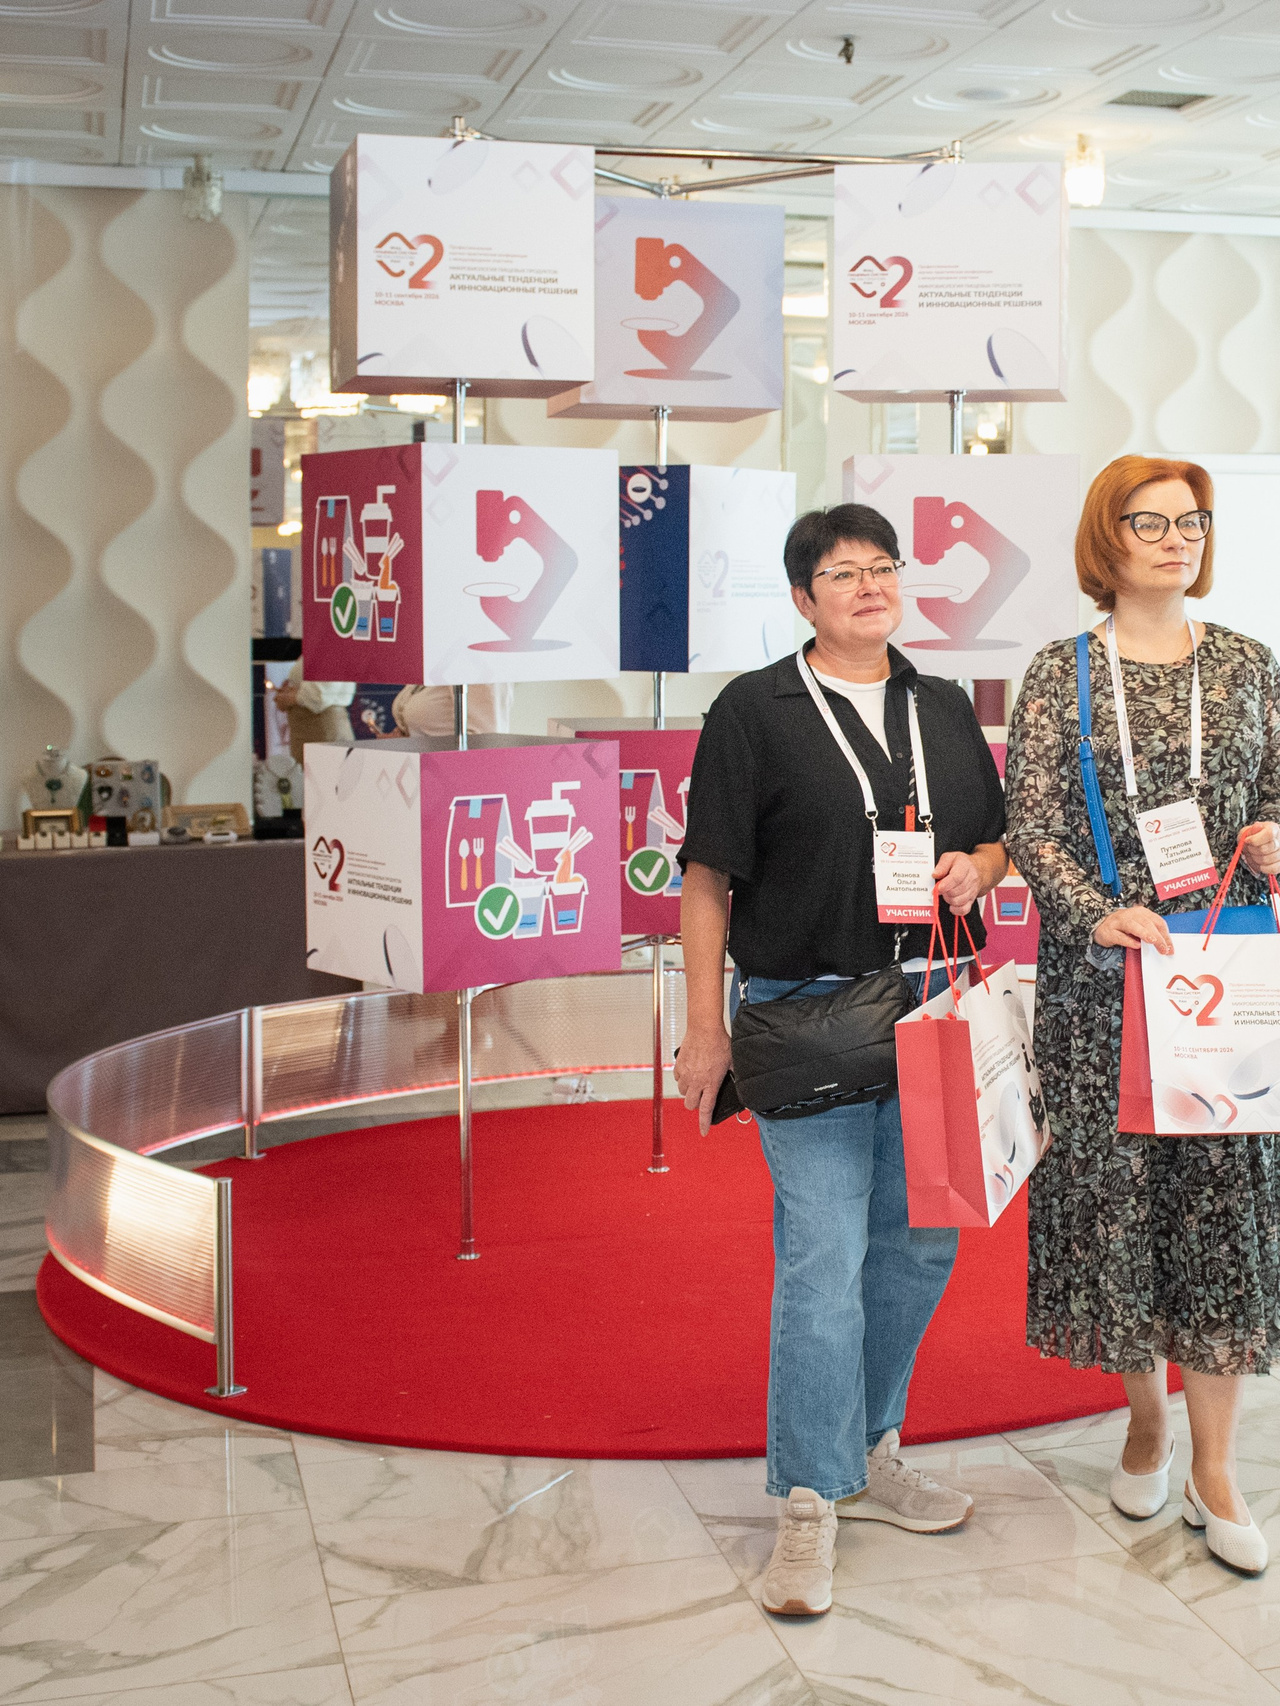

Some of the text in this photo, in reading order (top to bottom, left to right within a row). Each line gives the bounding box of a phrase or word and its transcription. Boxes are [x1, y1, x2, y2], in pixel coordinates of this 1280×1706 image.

[449, 273, 558, 285] АКТУАЛЬНЫЕ ТЕНДЕНЦИИ
[458, 284, 536, 294] ИННОВАЦИОННЫЕ
[538, 287, 578, 296] РЕШЕНИЯ
[918, 290, 1023, 299] АКТУАЛЬНЫЕ ТЕНДЕНЦИИ
[926, 300, 1001, 309] ИННОВАЦИОННЫЕ
[1003, 299, 1042, 307] РЕШЕНИЯ
[1160, 840, 1193, 853] Путилова
[1166, 847, 1192, 859] Татьяна
[1159, 851, 1202, 868] Анатольевна
[1163, 872, 1211, 893] УЧАСТНИК
[885, 909, 931, 917] УЧАСТНИК
